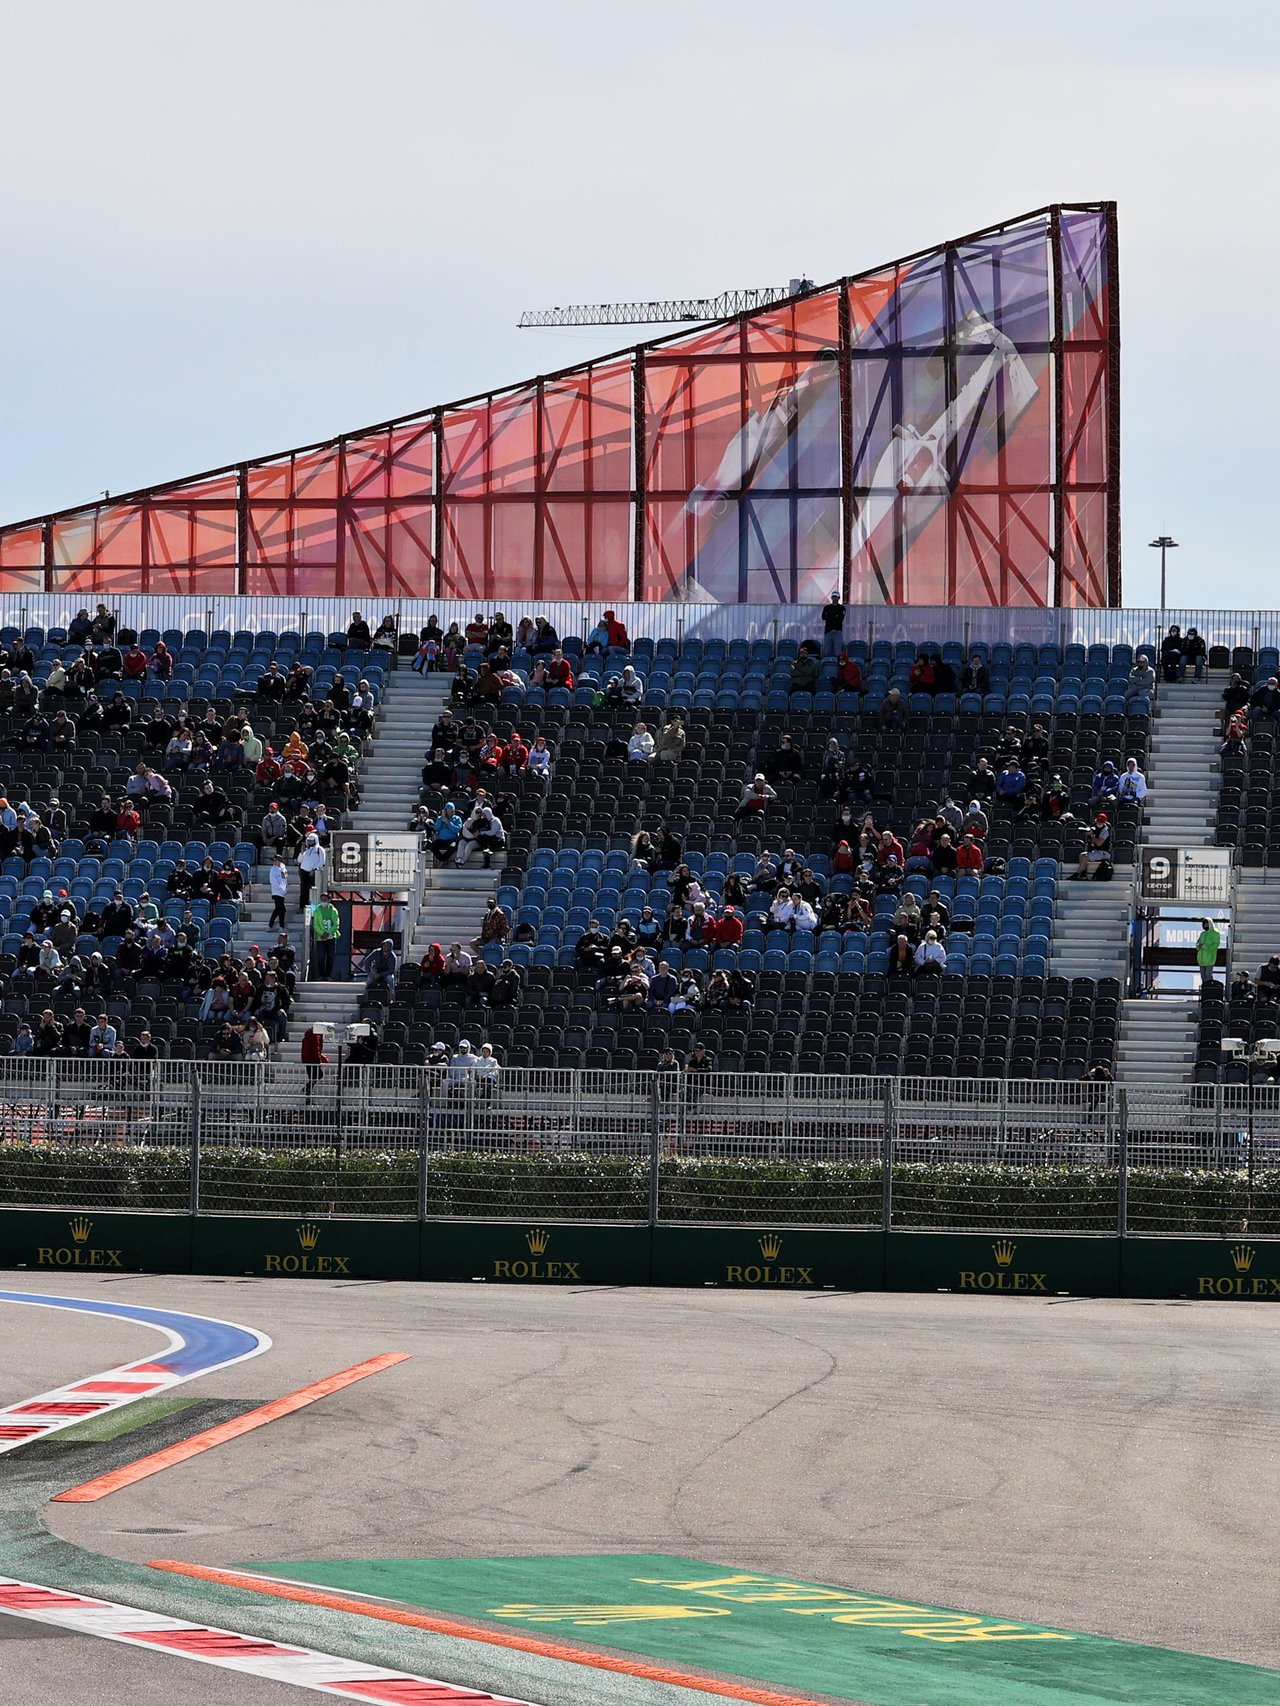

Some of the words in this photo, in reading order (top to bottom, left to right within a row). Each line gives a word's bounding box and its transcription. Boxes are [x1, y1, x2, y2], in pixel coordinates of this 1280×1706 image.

[341, 842, 361, 864] 8
[1150, 856, 1171, 880] 9
[37, 1247, 123, 1266] ROLEX
[264, 1254, 351, 1274] ROLEX
[493, 1260, 581, 1279] ROLEX
[726, 1265, 814, 1284] ROLEX
[959, 1271, 1048, 1290] ROLEX
[631, 1575, 1078, 1643] ROLEX
